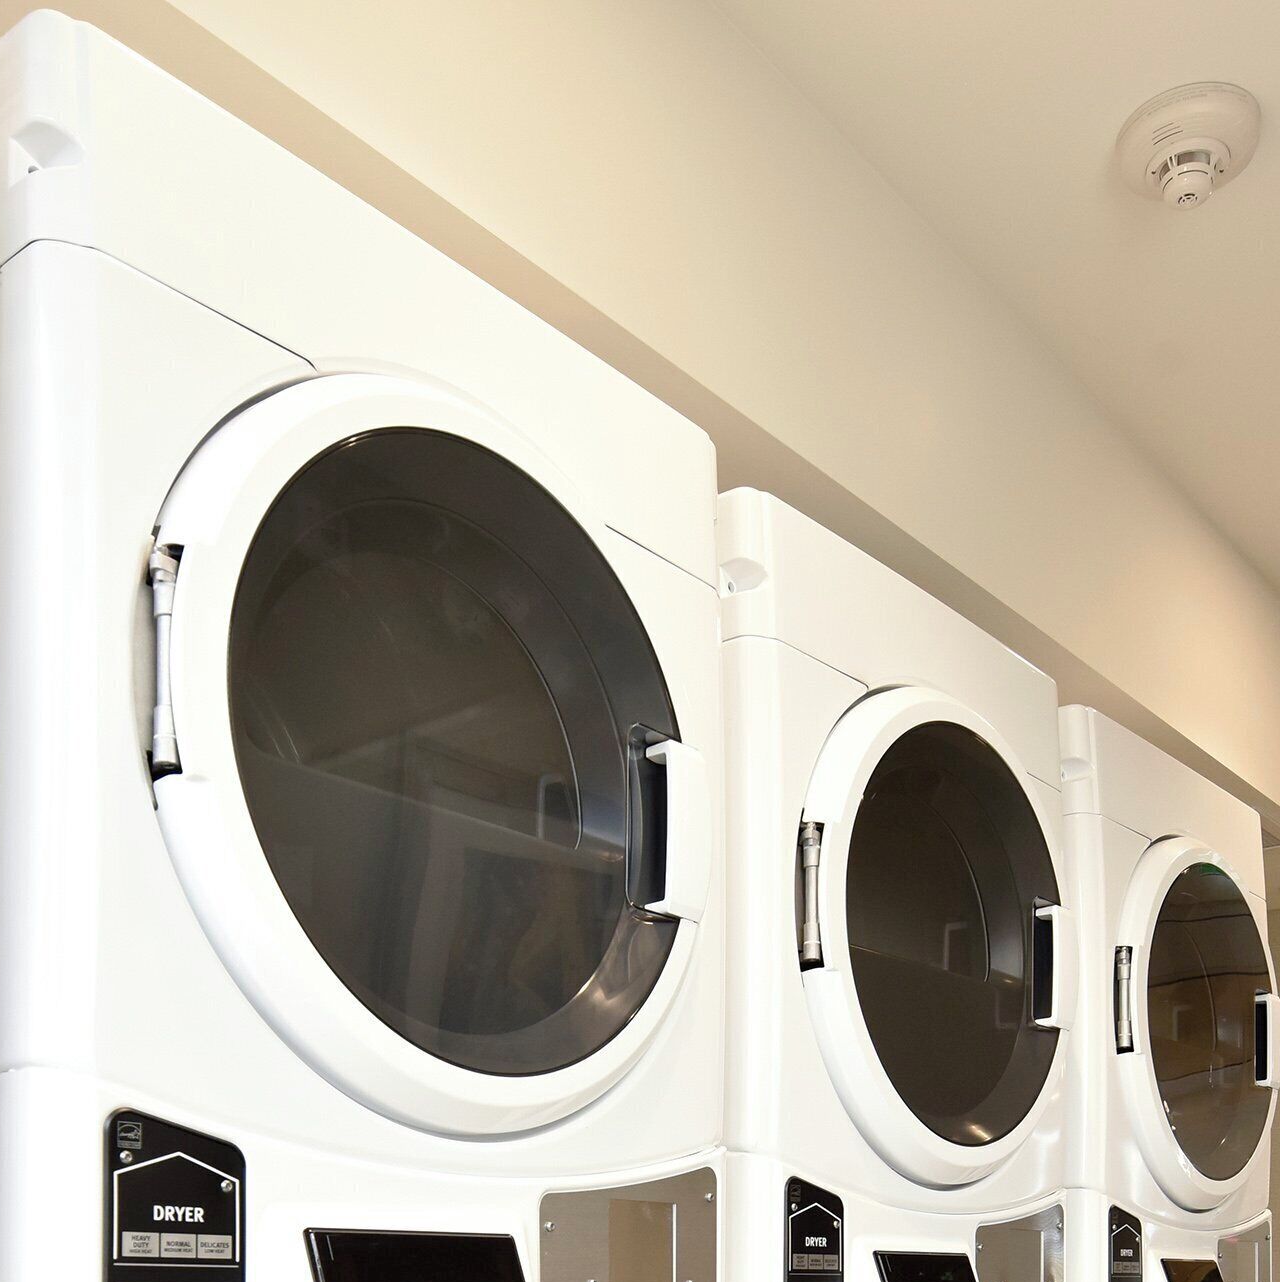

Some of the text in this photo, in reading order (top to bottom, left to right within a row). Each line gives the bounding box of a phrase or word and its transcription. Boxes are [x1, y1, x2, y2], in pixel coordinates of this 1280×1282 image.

[153, 1204, 205, 1223] DRYER
[805, 1236, 827, 1249] DRYER
[1120, 1249, 1134, 1257] DRYER
